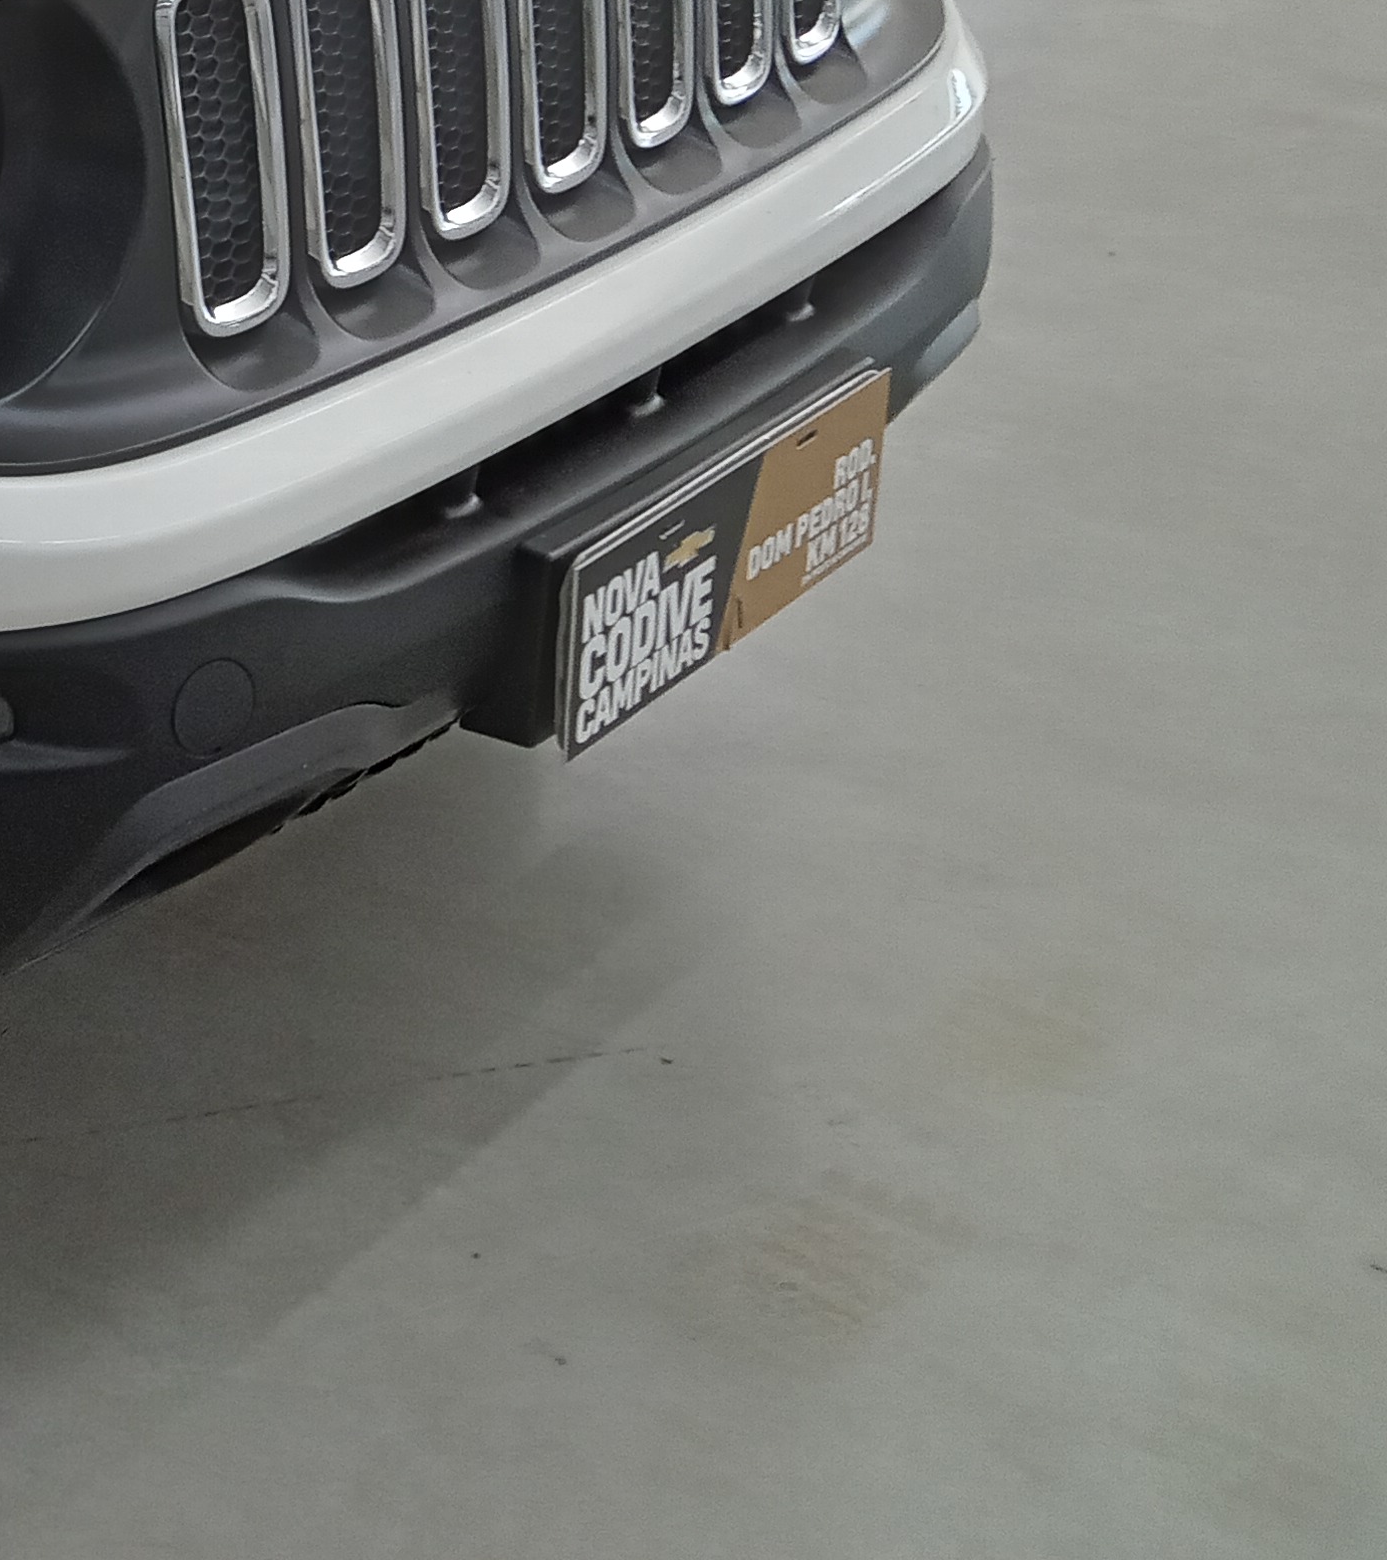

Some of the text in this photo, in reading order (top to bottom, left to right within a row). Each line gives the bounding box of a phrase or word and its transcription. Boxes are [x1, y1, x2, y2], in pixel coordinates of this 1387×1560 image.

[746, 522, 794, 581] DOM
[794, 478, 861, 549] PEDRO
[805, 524, 838, 573] KM
[579, 555, 717, 700] CODIVE
[582, 550, 661, 644] NOVA
[576, 617, 712, 744] CAMPINAS
